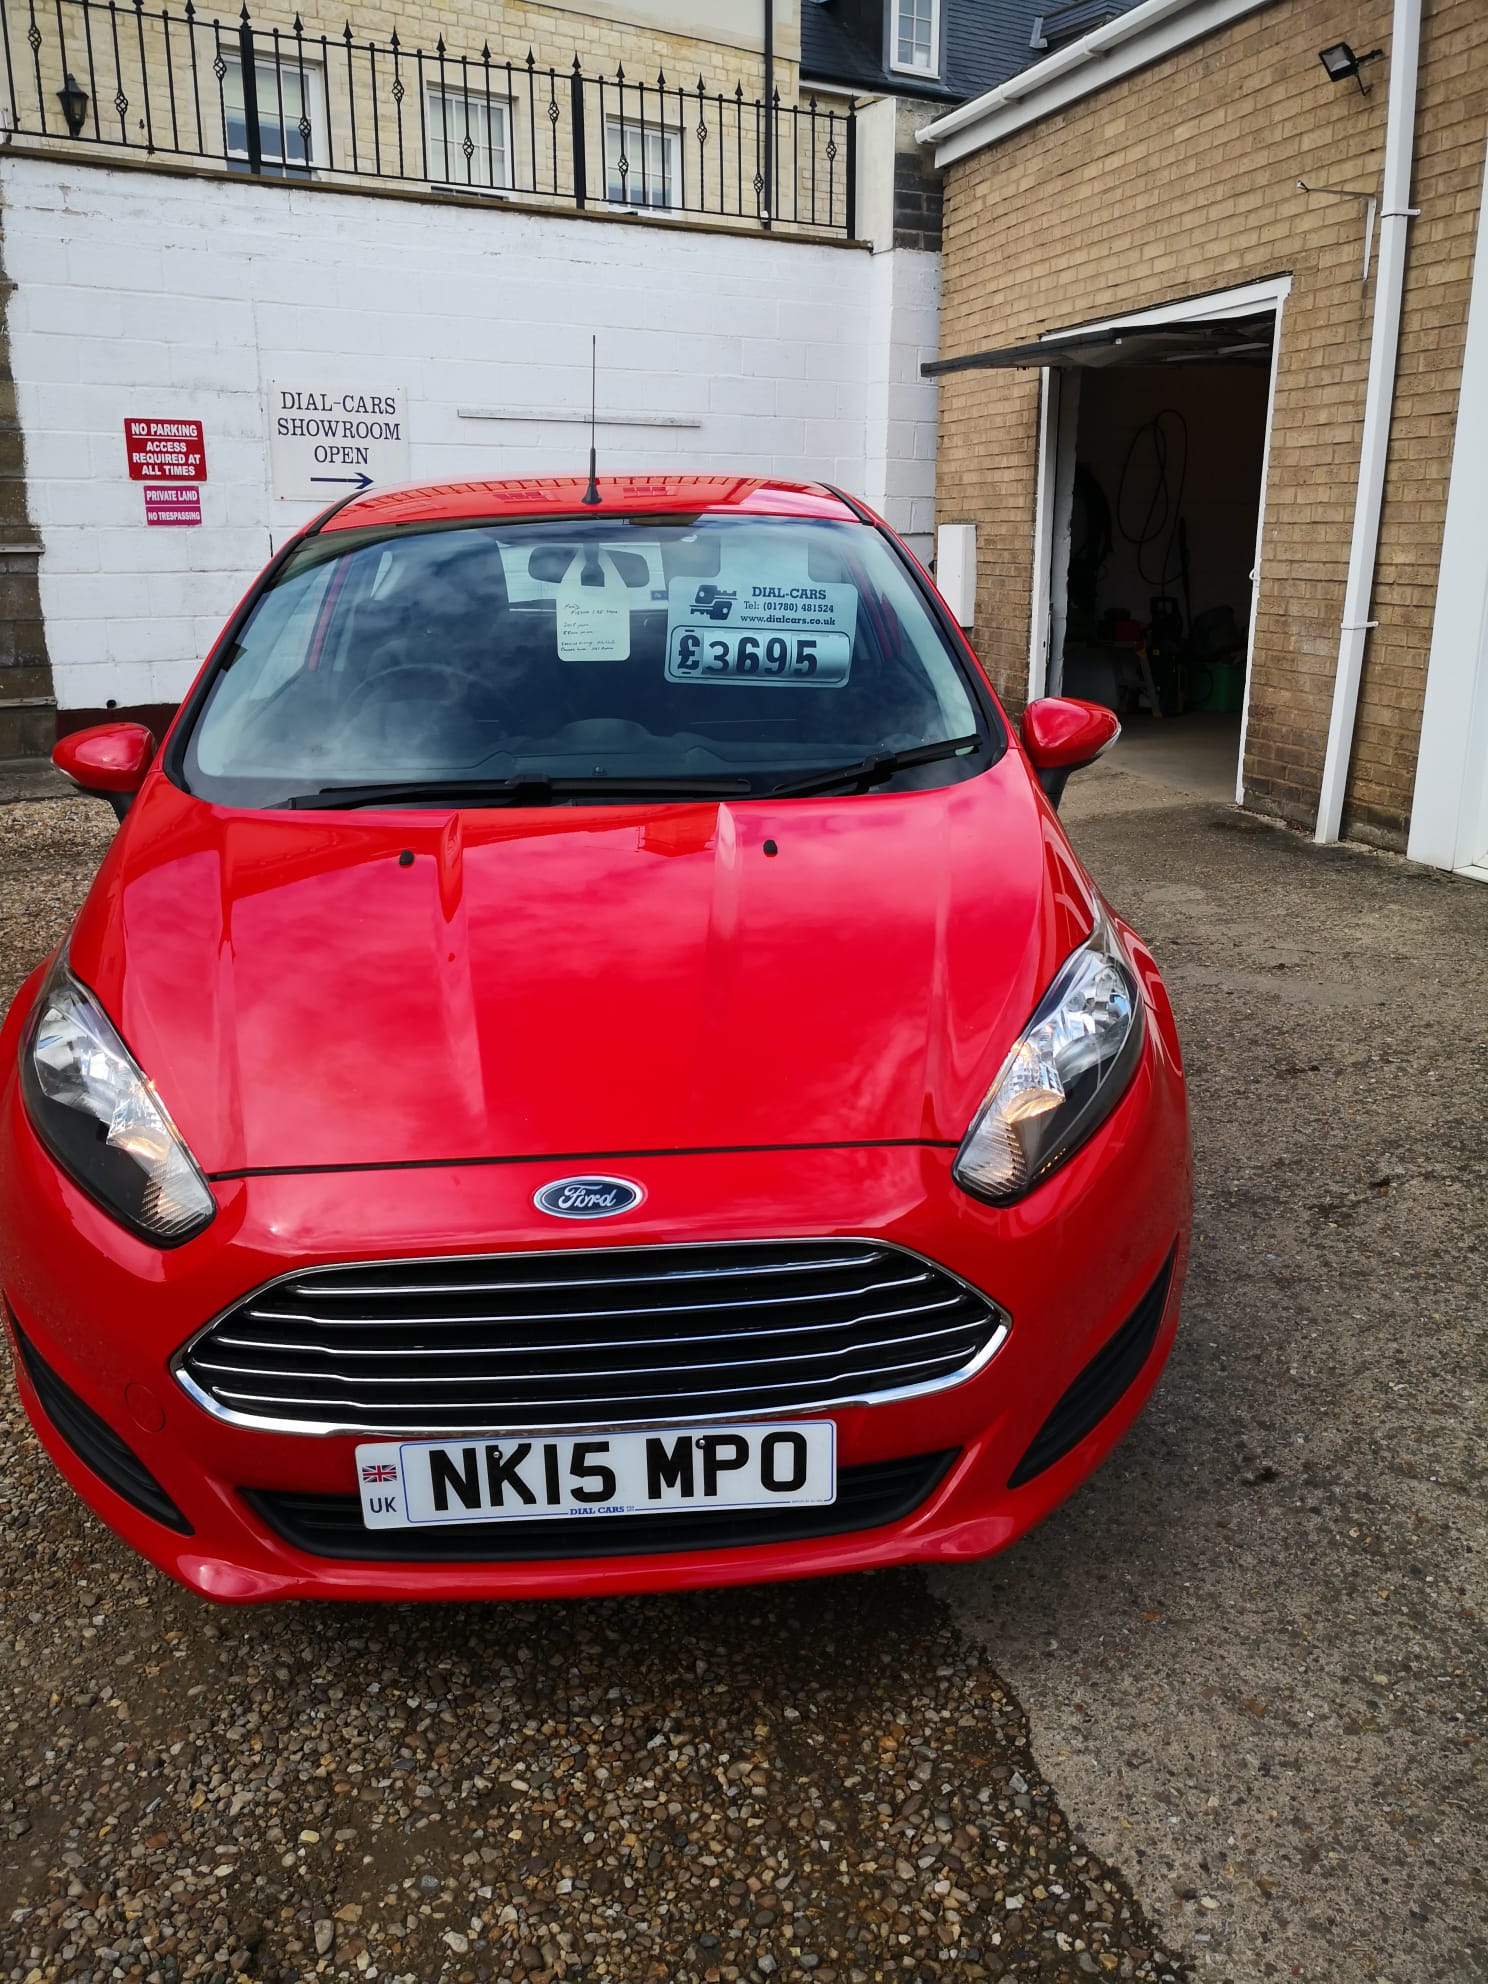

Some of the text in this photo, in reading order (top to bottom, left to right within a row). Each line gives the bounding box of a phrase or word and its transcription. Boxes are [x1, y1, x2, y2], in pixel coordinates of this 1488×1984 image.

[280, 391, 396, 415] DIAL-CARS
[131, 422, 198, 437] NO PARKING
[277, 418, 401, 441] SHOWROOM
[146, 441, 187, 452] ACCESS
[132, 452, 201, 464] REQUIRED AT
[314, 445, 370, 465] OPEN
[141, 465, 196, 476] ALL TIMES
[146, 490, 198, 501] PRIVATE LAND
[148, 511, 201, 520] NO TRESPASSING
[751, 586, 827, 600] DIAL-CARS
[743, 600, 834, 613] Tel: (01780) 481524
[740, 614, 836, 625] www.dialcars.co.uk
[558, 1184, 617, 1208] Ford
[428, 1430, 808, 1511] NK15 MPO
[370, 1496, 397, 1514] UK
[597, 1505, 625, 1514] CARS
